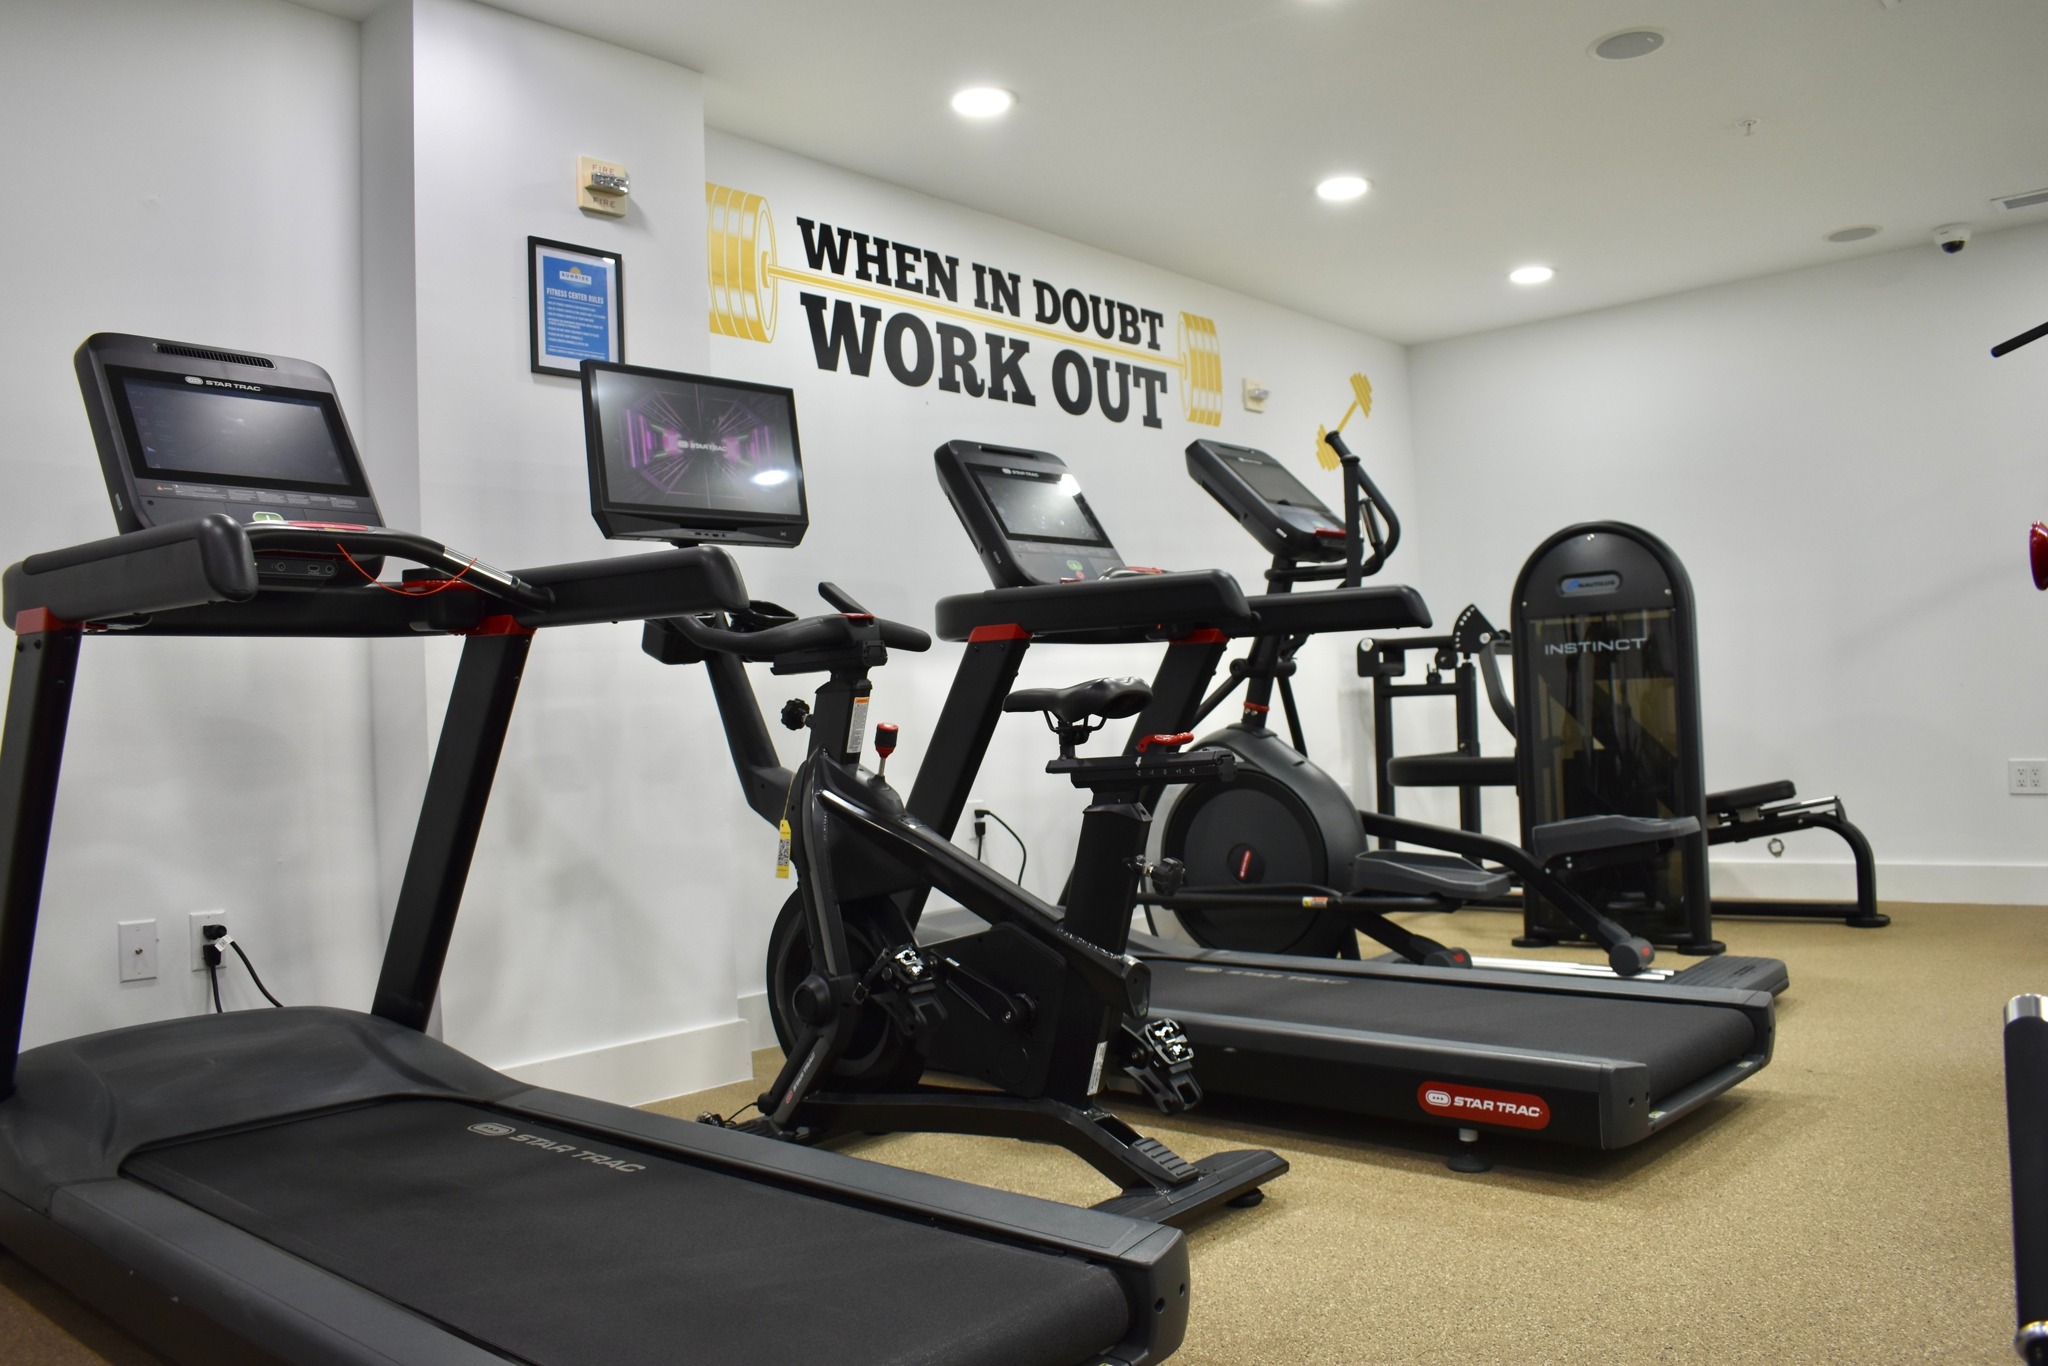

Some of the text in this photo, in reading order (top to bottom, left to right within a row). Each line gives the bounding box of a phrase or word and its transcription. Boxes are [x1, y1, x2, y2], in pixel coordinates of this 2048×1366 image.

[593, 197, 616, 208] FIRE
[796, 216, 1164, 351] WHEN IN DOUBT
[546, 287, 604, 304] FITNESS CENTER RULES
[800, 291, 1168, 429] WORK OUT
[205, 380, 261, 392] STAR TRAC
[1545, 637, 1648, 656] INSTINCT
[1453, 1096, 1541, 1117] STAR TRAC
[508, 1134, 646, 1172] STAR TRAC
